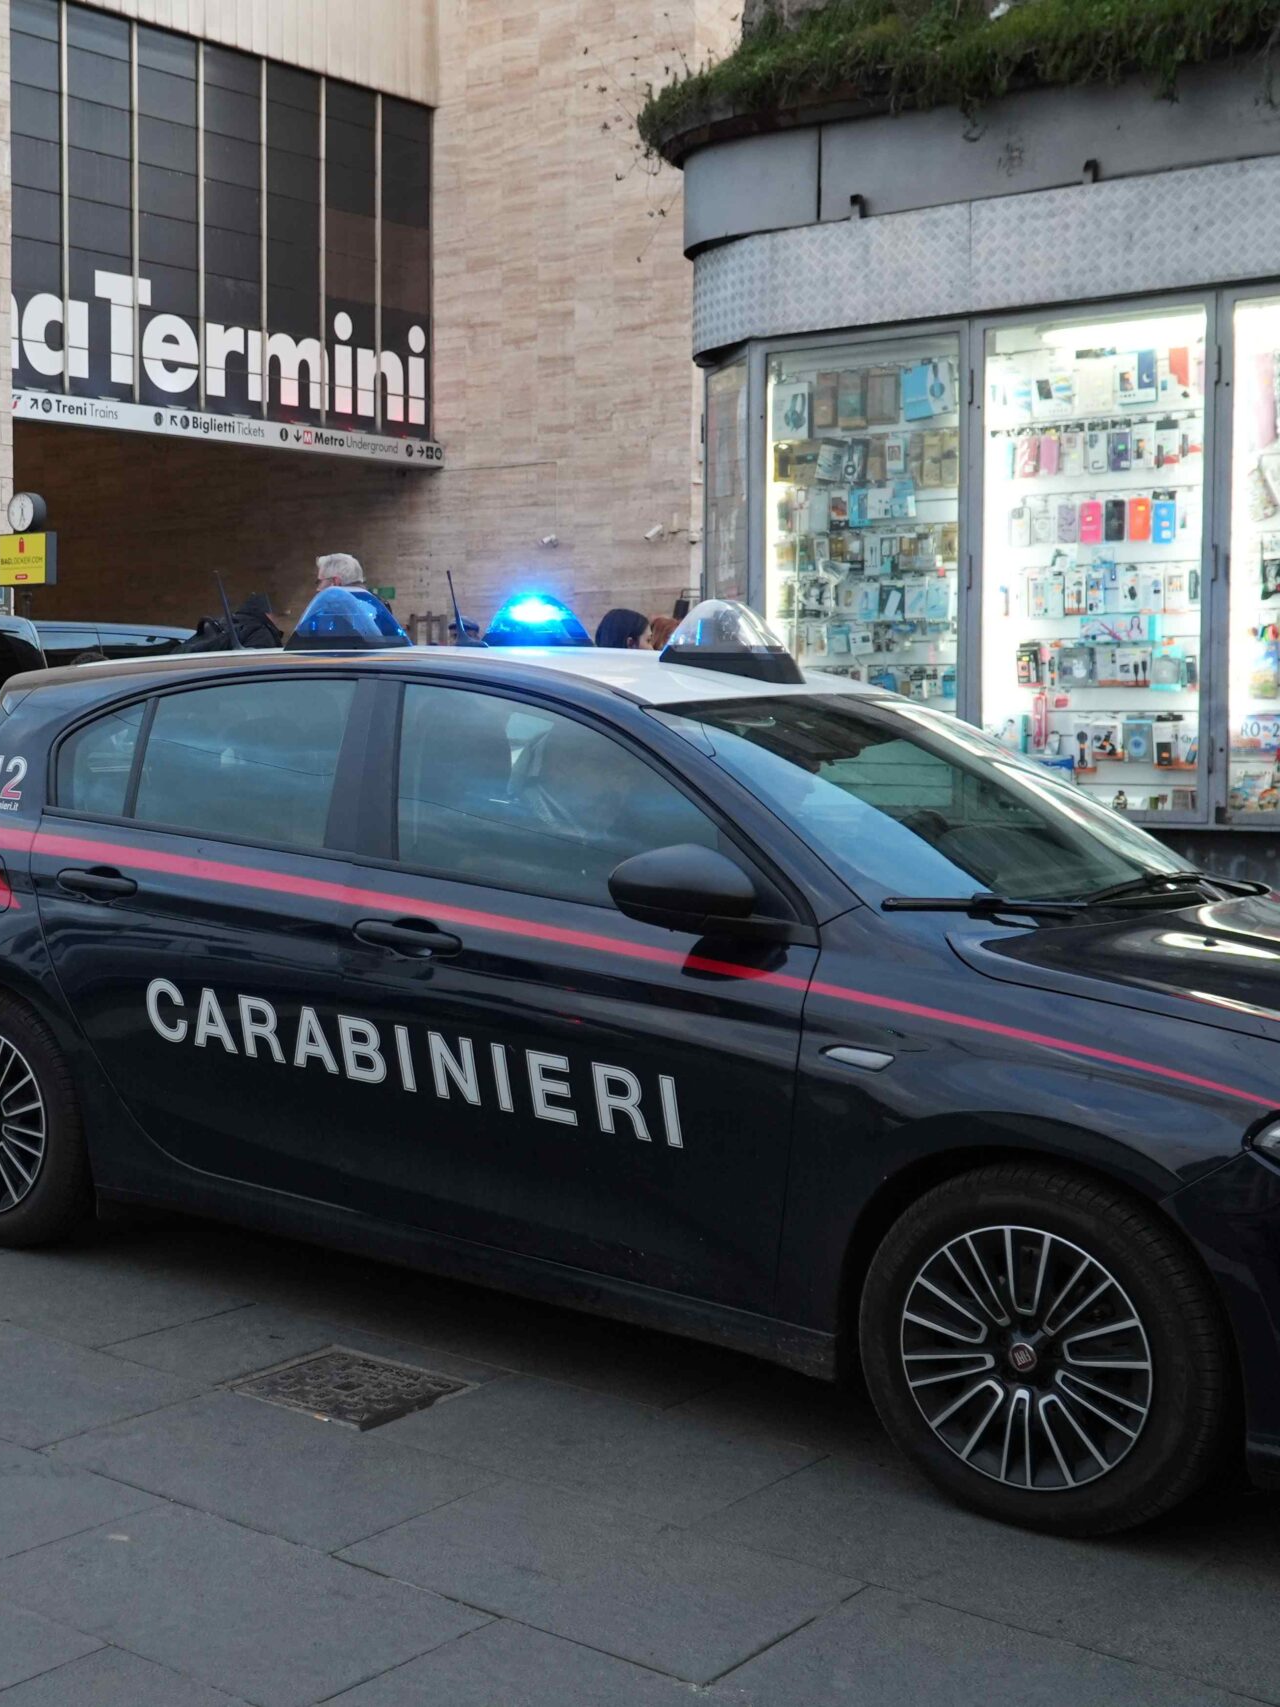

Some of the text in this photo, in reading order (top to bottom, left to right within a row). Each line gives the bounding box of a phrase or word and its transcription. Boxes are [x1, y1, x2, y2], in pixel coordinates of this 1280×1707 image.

[11, 269, 426, 425] aTermini
[55, 399, 119, 420] Treni Trains
[192, 416, 265, 438] Biglietti Tickets
[314, 432, 345, 447] Metro
[346, 435, 399, 454] Underground
[145, 976, 685, 1149] CARABINIERI
